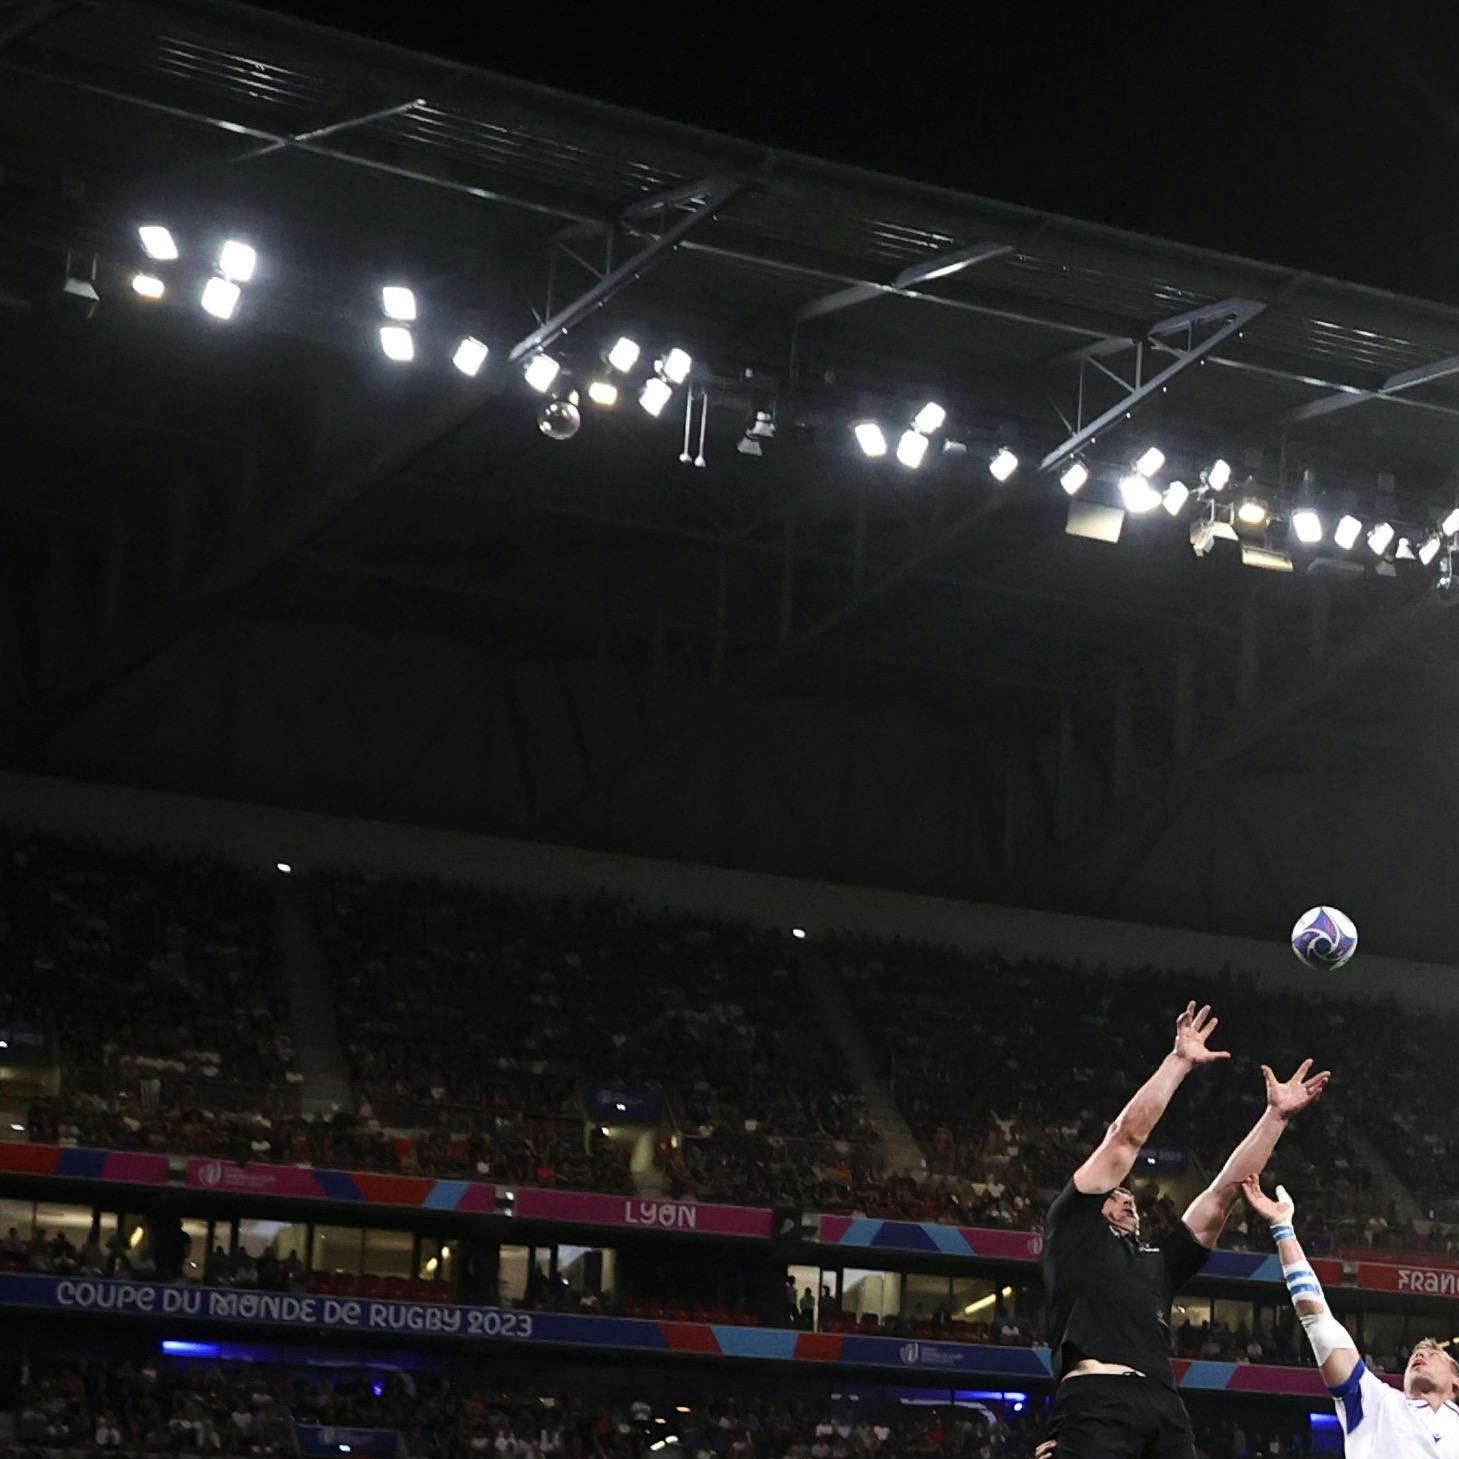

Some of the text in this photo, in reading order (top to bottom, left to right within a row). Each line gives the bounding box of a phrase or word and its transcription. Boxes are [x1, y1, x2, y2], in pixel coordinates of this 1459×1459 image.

[624, 1200, 697, 1229] LYON
[56, 1281, 156, 1311] COUPE
[162, 1288, 201, 1314] DU
[208, 1291, 317, 1323] MONDE
[368, 1303, 462, 1333] RUGBY
[466, 1311, 534, 1338] 2023
